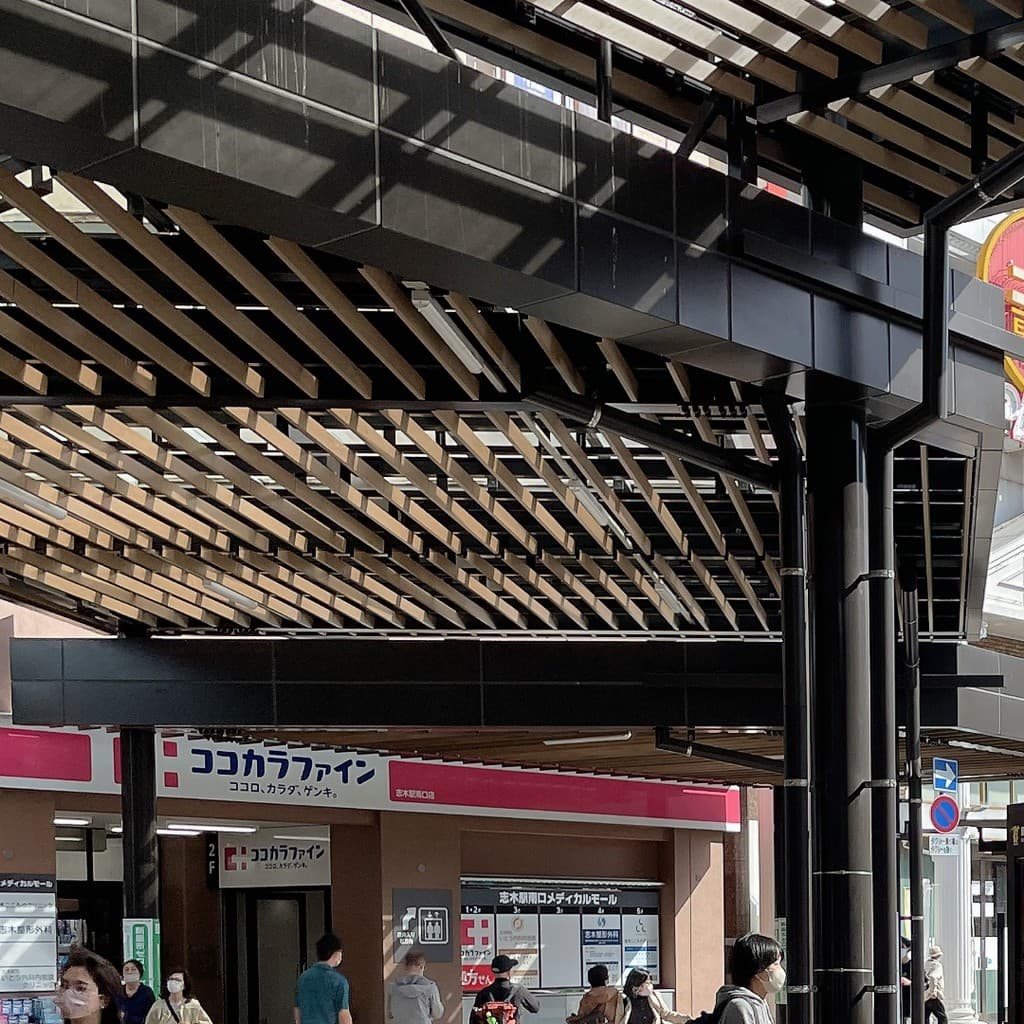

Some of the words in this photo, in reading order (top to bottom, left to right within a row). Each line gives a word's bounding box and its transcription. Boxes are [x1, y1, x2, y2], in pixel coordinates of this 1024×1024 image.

[191, 748, 375, 785] ココカラファイン
[229, 781, 338, 799] ココロ、カラダ、ゲンキ。
[251, 845, 325, 862] ココカラファイン
